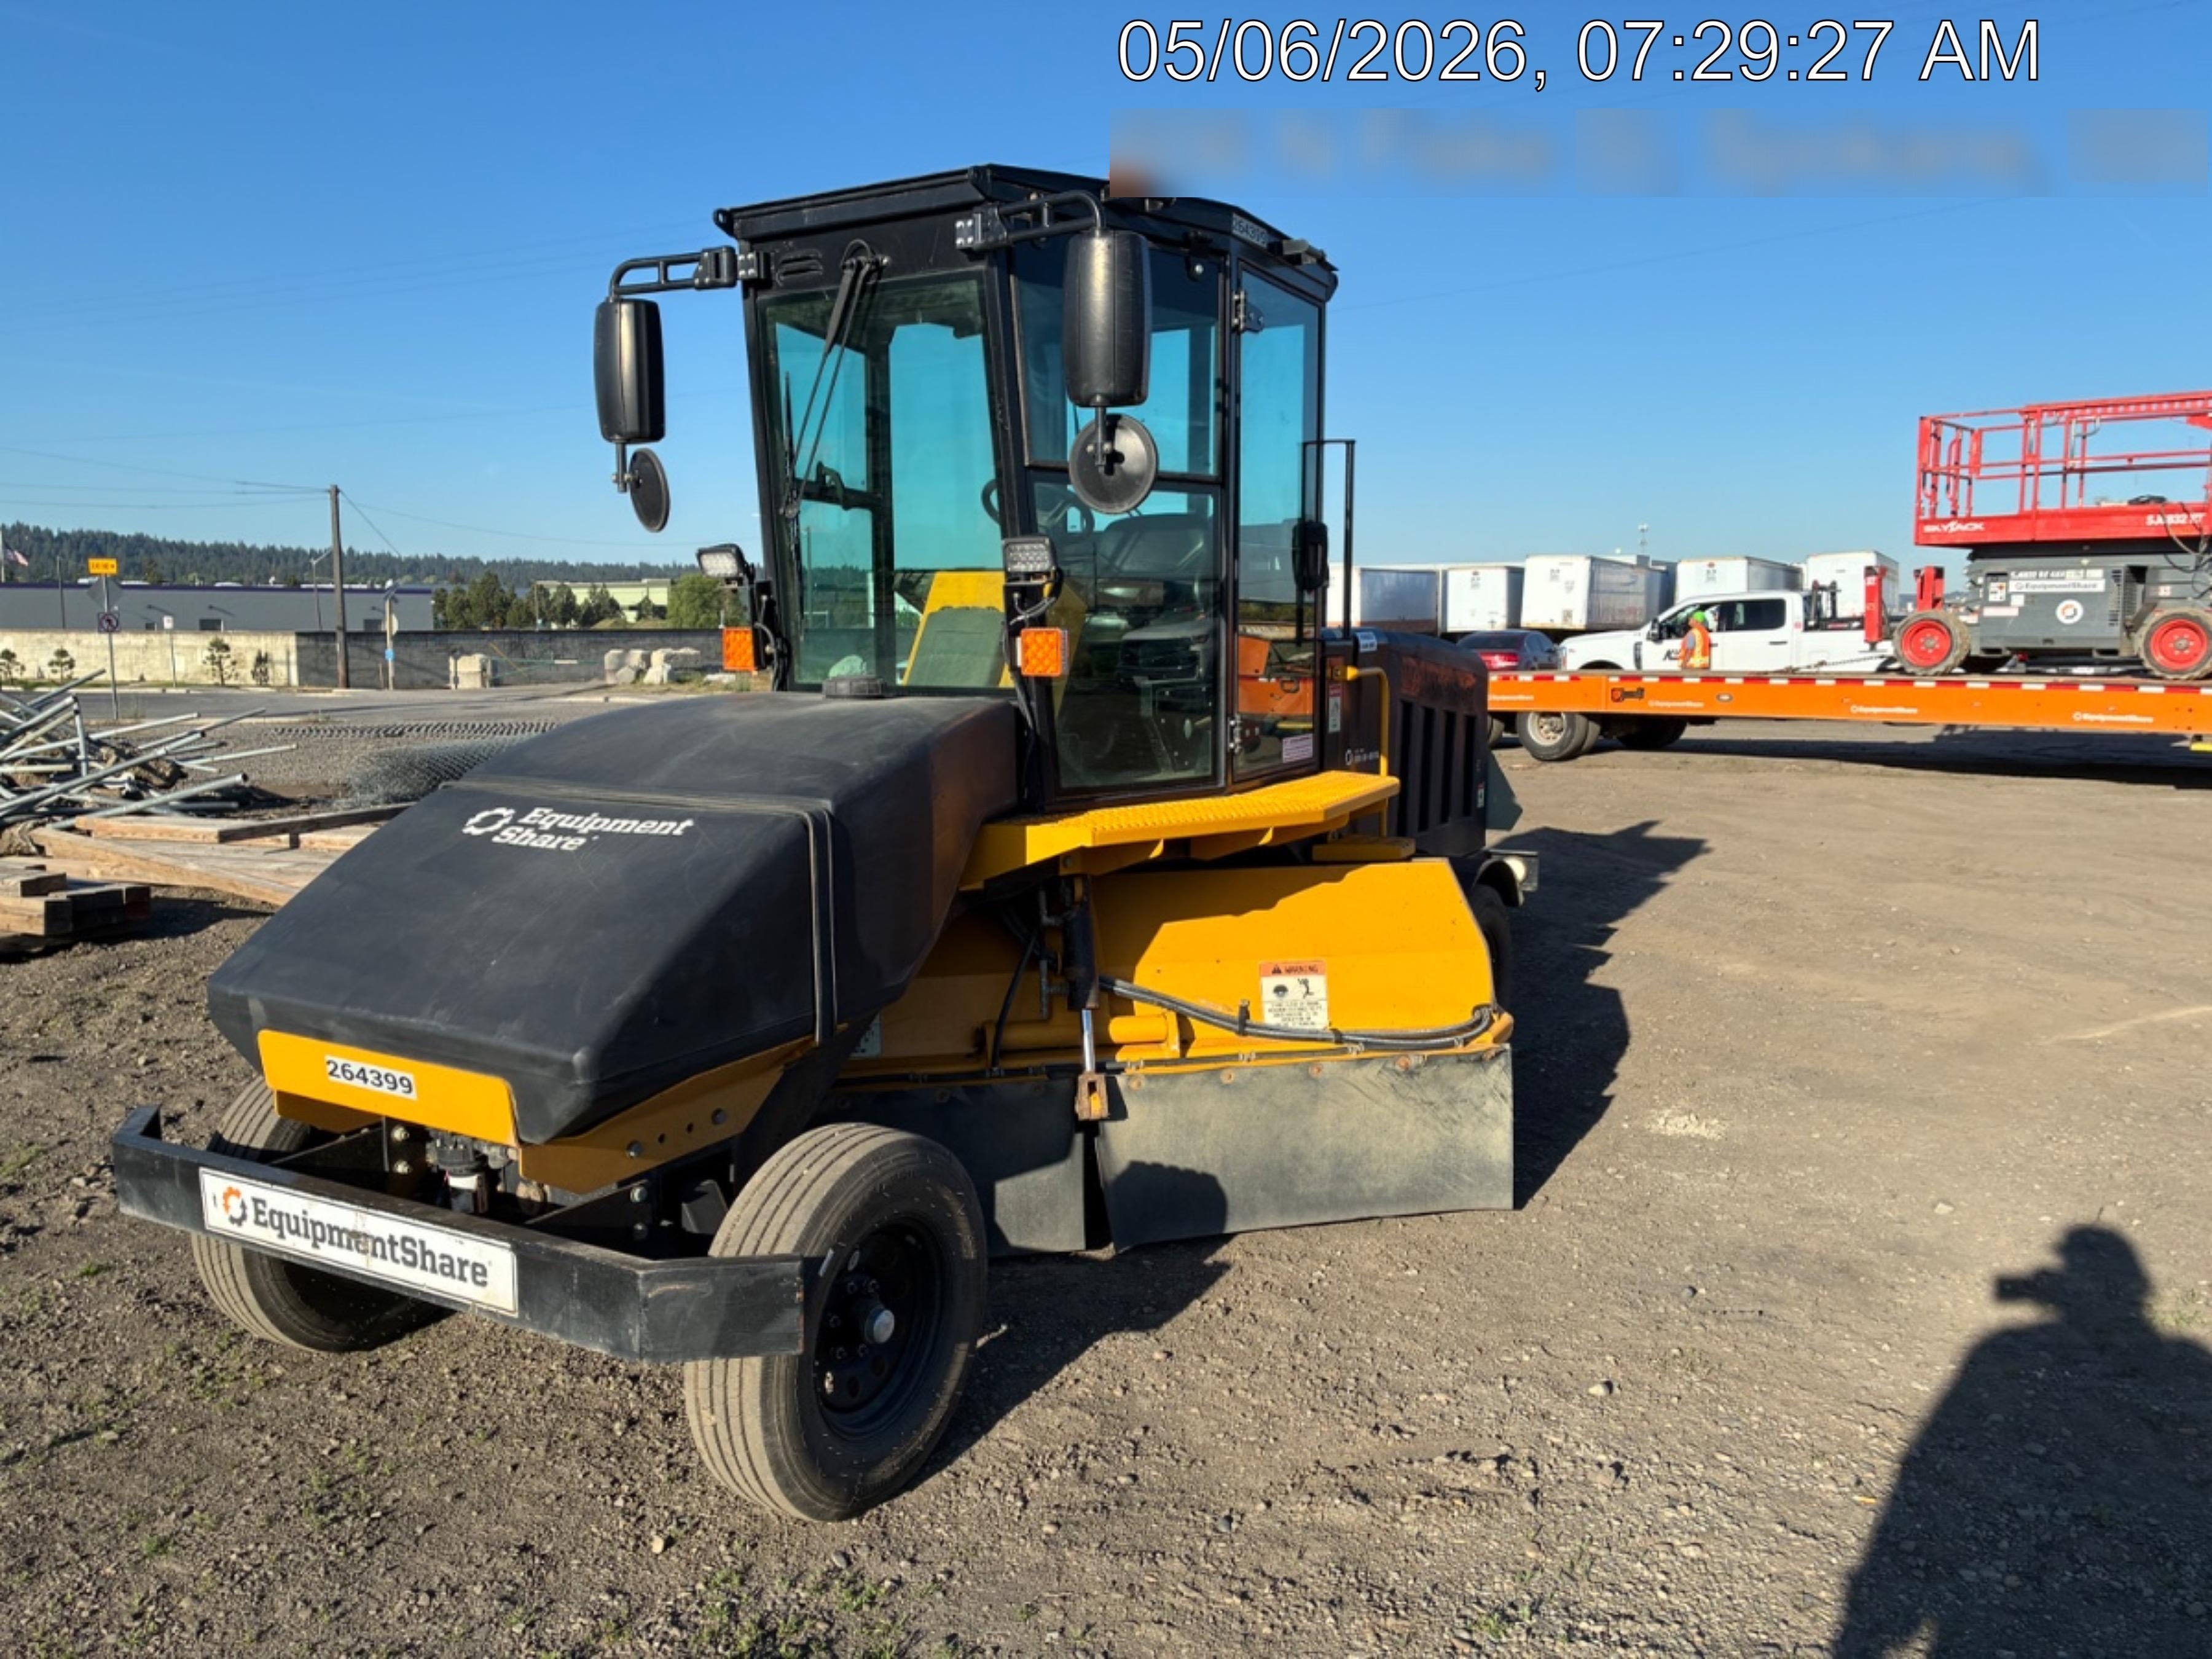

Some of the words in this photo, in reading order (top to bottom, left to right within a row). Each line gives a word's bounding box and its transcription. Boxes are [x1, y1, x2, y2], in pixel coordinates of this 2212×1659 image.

[517, 806, 694, 836] Equipment
[492, 825, 587, 852] Share
[326, 1059, 414, 1094] 264399
[252, 1198, 488, 1287] EquipmentShare
